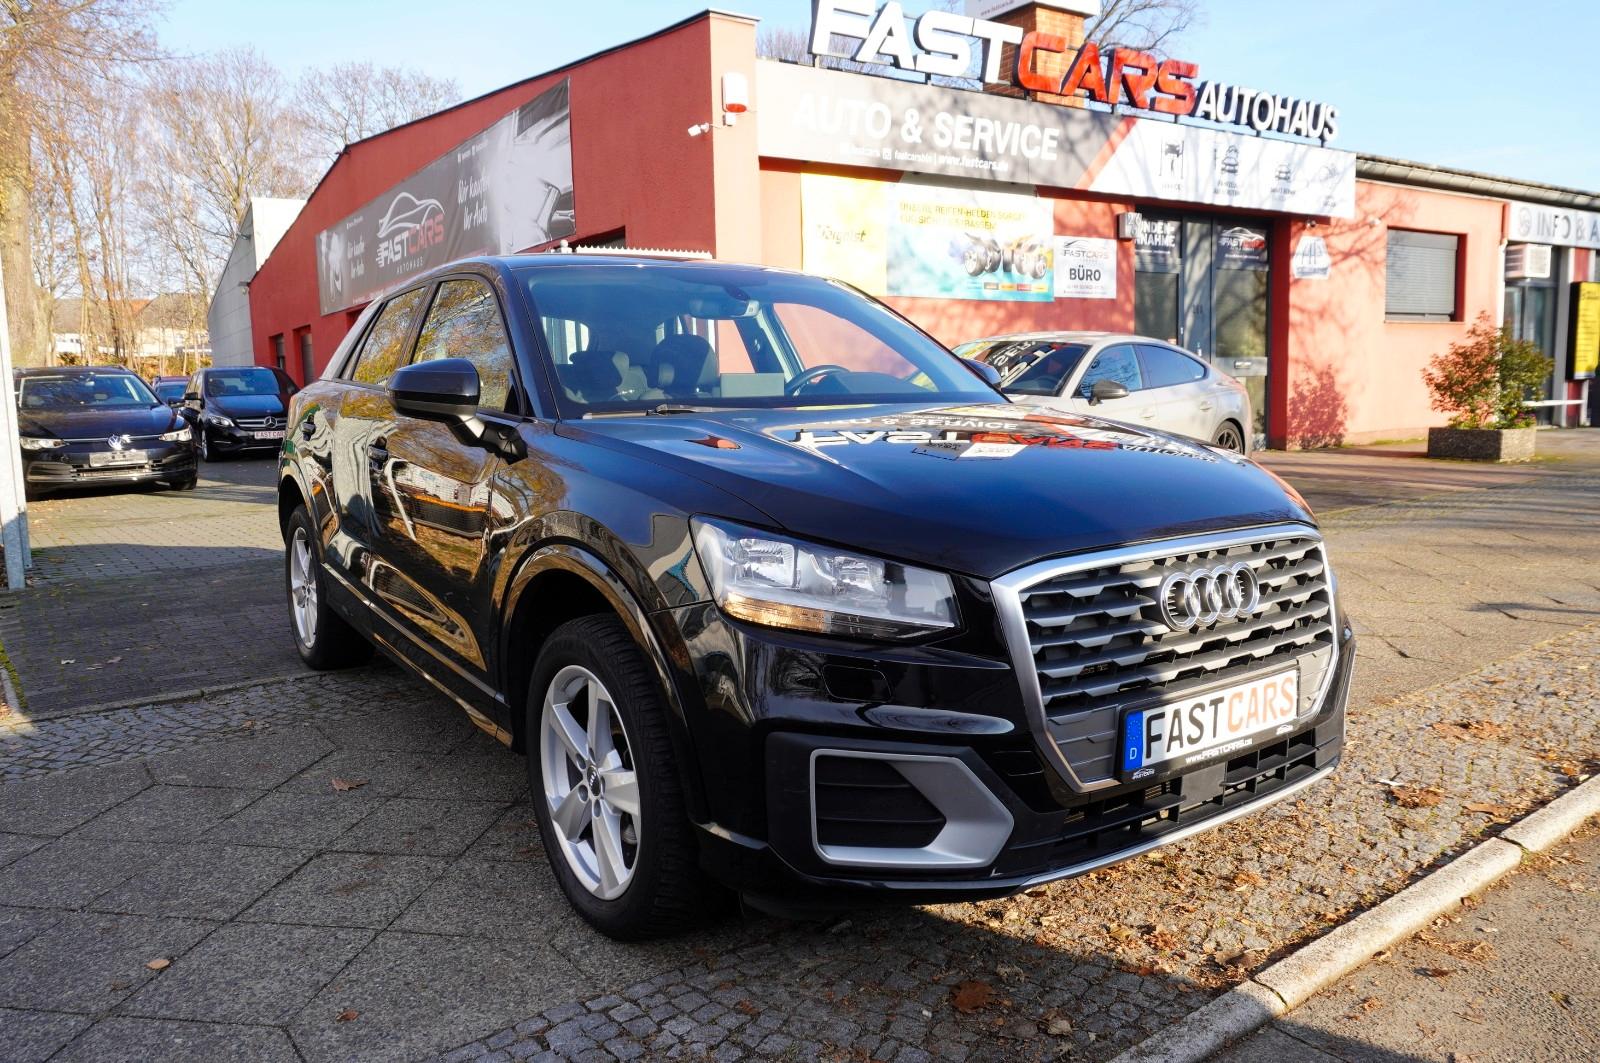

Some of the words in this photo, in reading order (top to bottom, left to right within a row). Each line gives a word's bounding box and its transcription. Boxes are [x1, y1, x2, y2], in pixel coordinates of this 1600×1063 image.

[811, 0, 1199, 116] FASTCARS
[792, 92, 891, 139] AUTO
[901, 108, 923, 144] &
[933, 111, 1060, 161] SERVICE
[1196, 80, 1339, 142] AUTOHAUS
[376, 213, 444, 268] FASTCARS
[1069, 264, 1102, 281] BÜRO
[1145, 676, 1295, 759] FASTCARS
[1129, 747, 1138, 761] D
